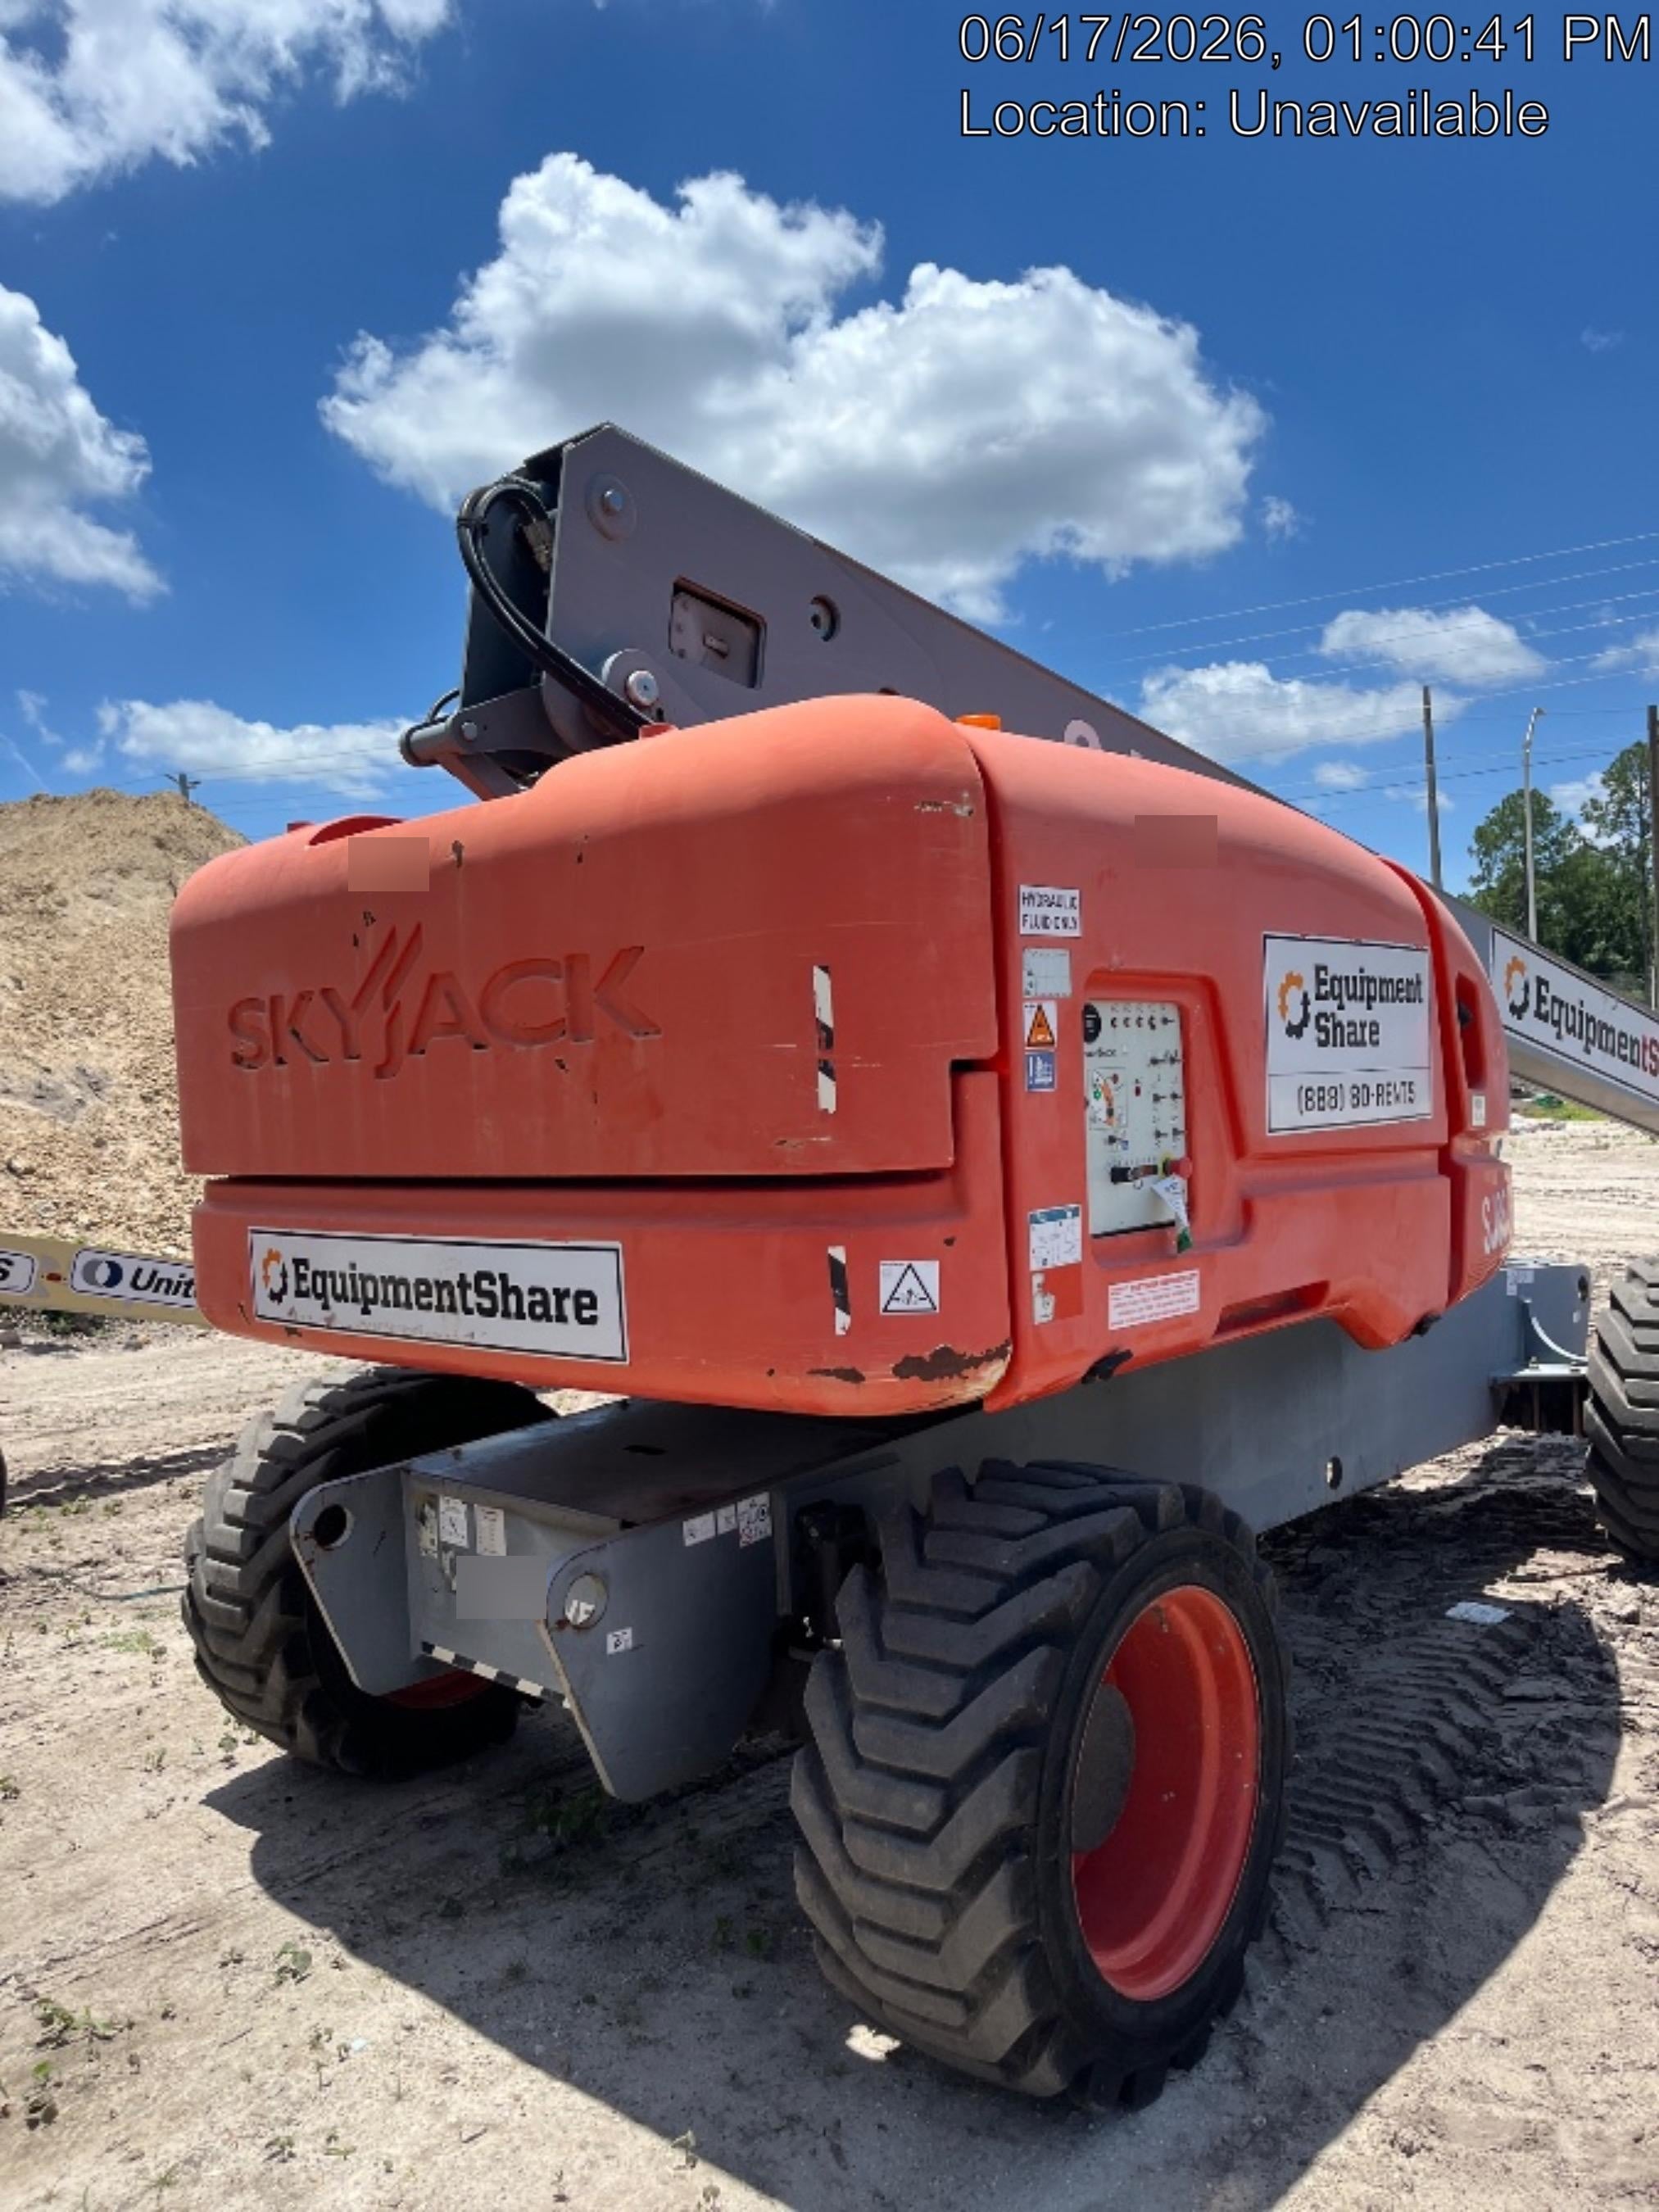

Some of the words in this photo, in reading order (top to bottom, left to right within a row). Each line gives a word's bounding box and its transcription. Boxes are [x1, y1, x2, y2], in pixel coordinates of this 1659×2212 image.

[227, 922, 662, 1080] SKYJACK
[1314, 964, 1424, 1013] Equipment
[1315, 1012, 1380, 1049] Share
[1298, 1083, 1345, 1116] (888)
[129, 1267, 197, 1299] Unit
[292, 1257, 600, 1326] EquipmentShare
